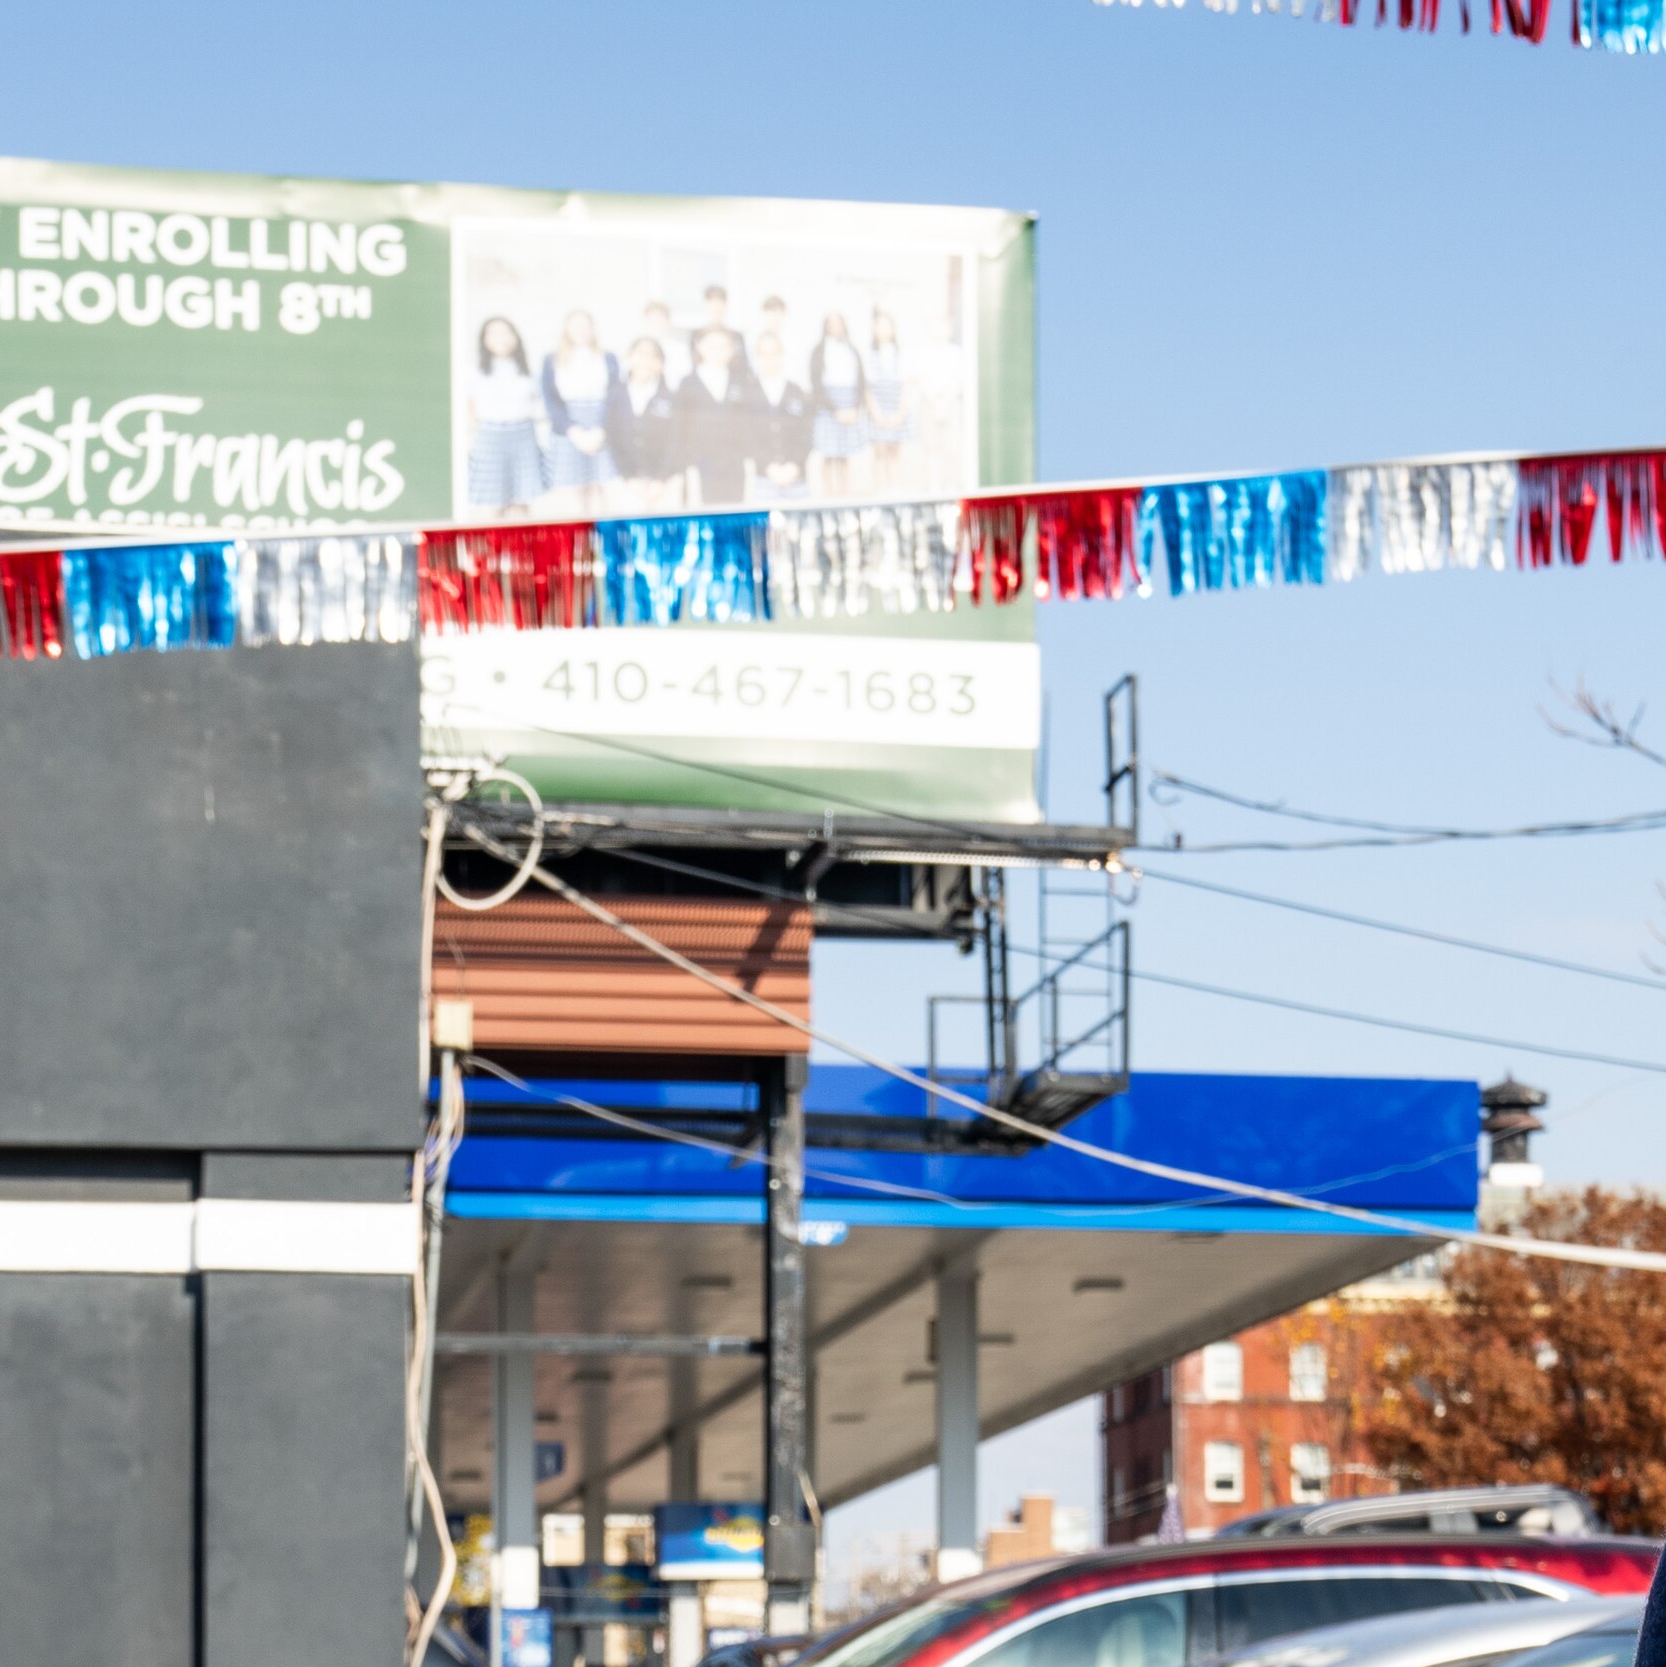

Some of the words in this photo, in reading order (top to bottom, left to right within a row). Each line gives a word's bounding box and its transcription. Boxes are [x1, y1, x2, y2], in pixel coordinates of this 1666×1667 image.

[18, 206, 408, 277] ENROLLING
[100, 394, 406, 516] Francis
[540, 658, 978, 717] 410-467-1683
